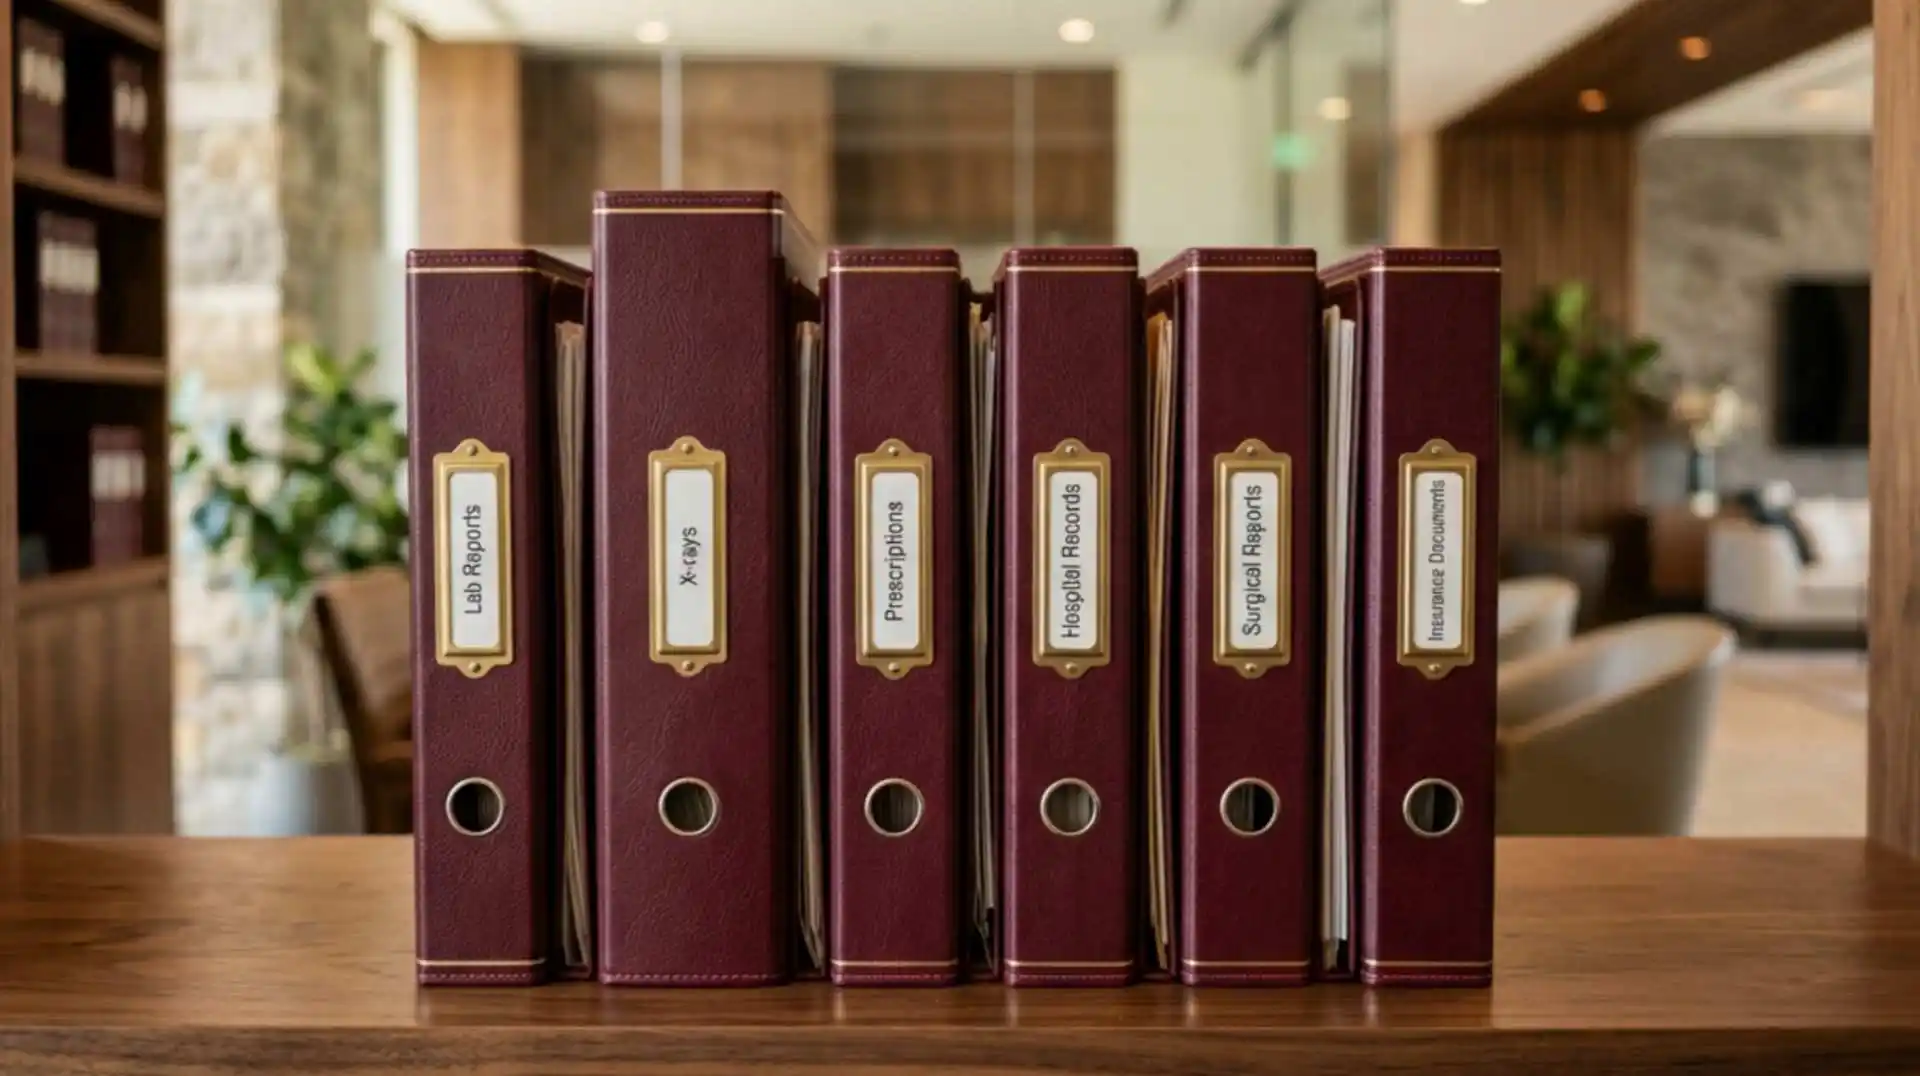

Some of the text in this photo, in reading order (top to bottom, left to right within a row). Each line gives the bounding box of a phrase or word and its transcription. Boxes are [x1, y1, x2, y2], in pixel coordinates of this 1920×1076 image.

[681, 527, 701, 586] X-rays
[885, 501, 906, 621] Prescriptions
[1061, 484, 1085, 638] Hospital Records
[464, 582, 482, 614] Lab
[1242, 562, 1266, 636] Surgical
